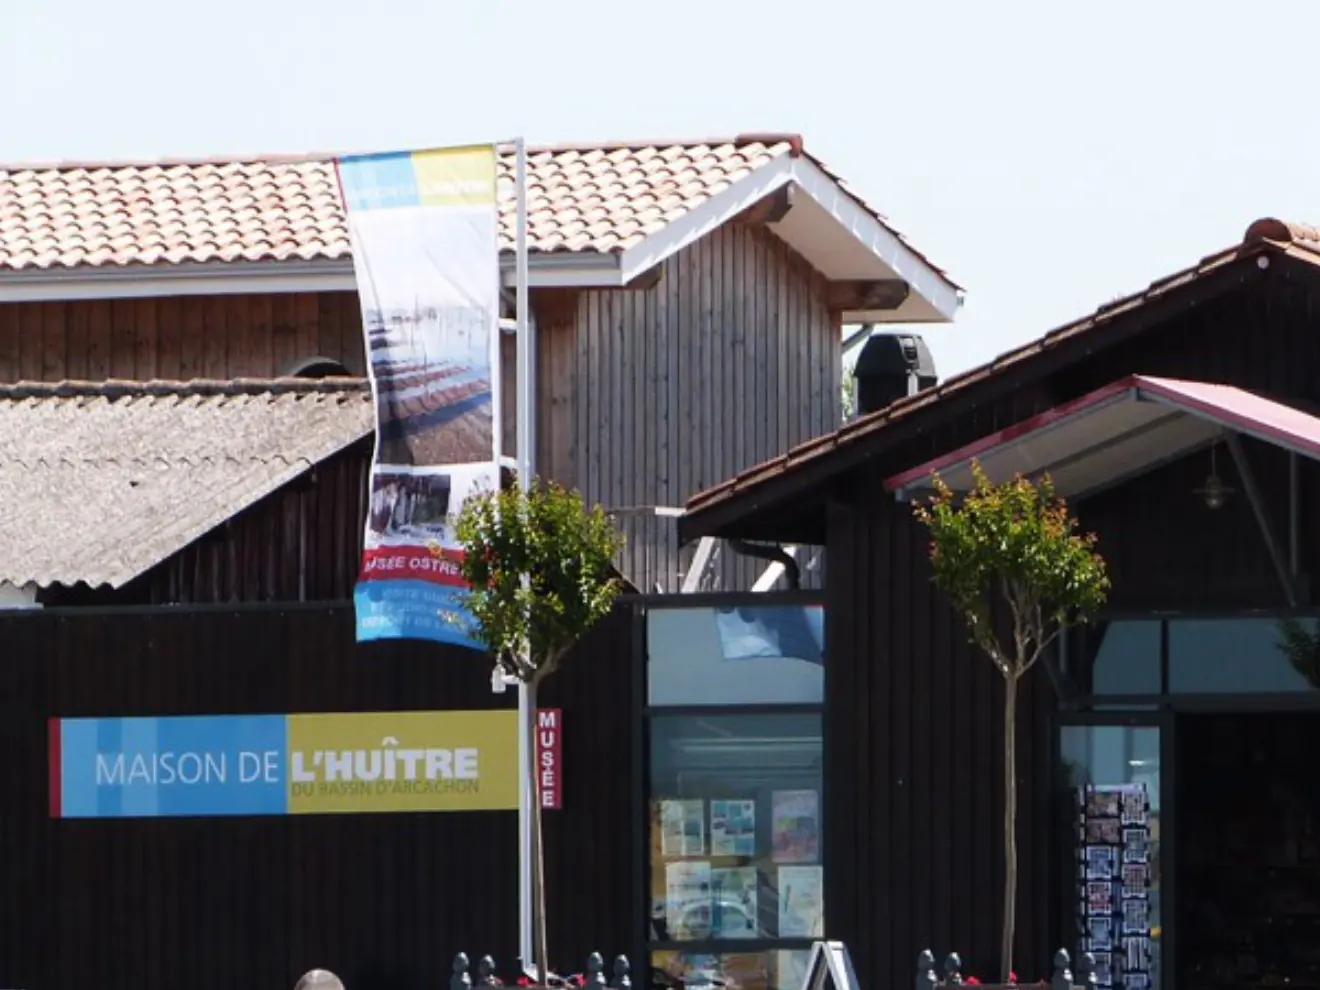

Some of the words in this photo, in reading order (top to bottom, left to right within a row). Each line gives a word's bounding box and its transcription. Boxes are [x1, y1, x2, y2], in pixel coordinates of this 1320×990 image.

[408, 556, 466, 576] OSTRE
[95, 752, 227, 786] MAISON
[238, 751, 279, 783] DE
[291, 736, 479, 782] L'HUÎTRE
[291, 783, 313, 798] DU
[318, 781, 371, 797] BASSIN
[375, 778, 480, 796] D'ARCACHON
